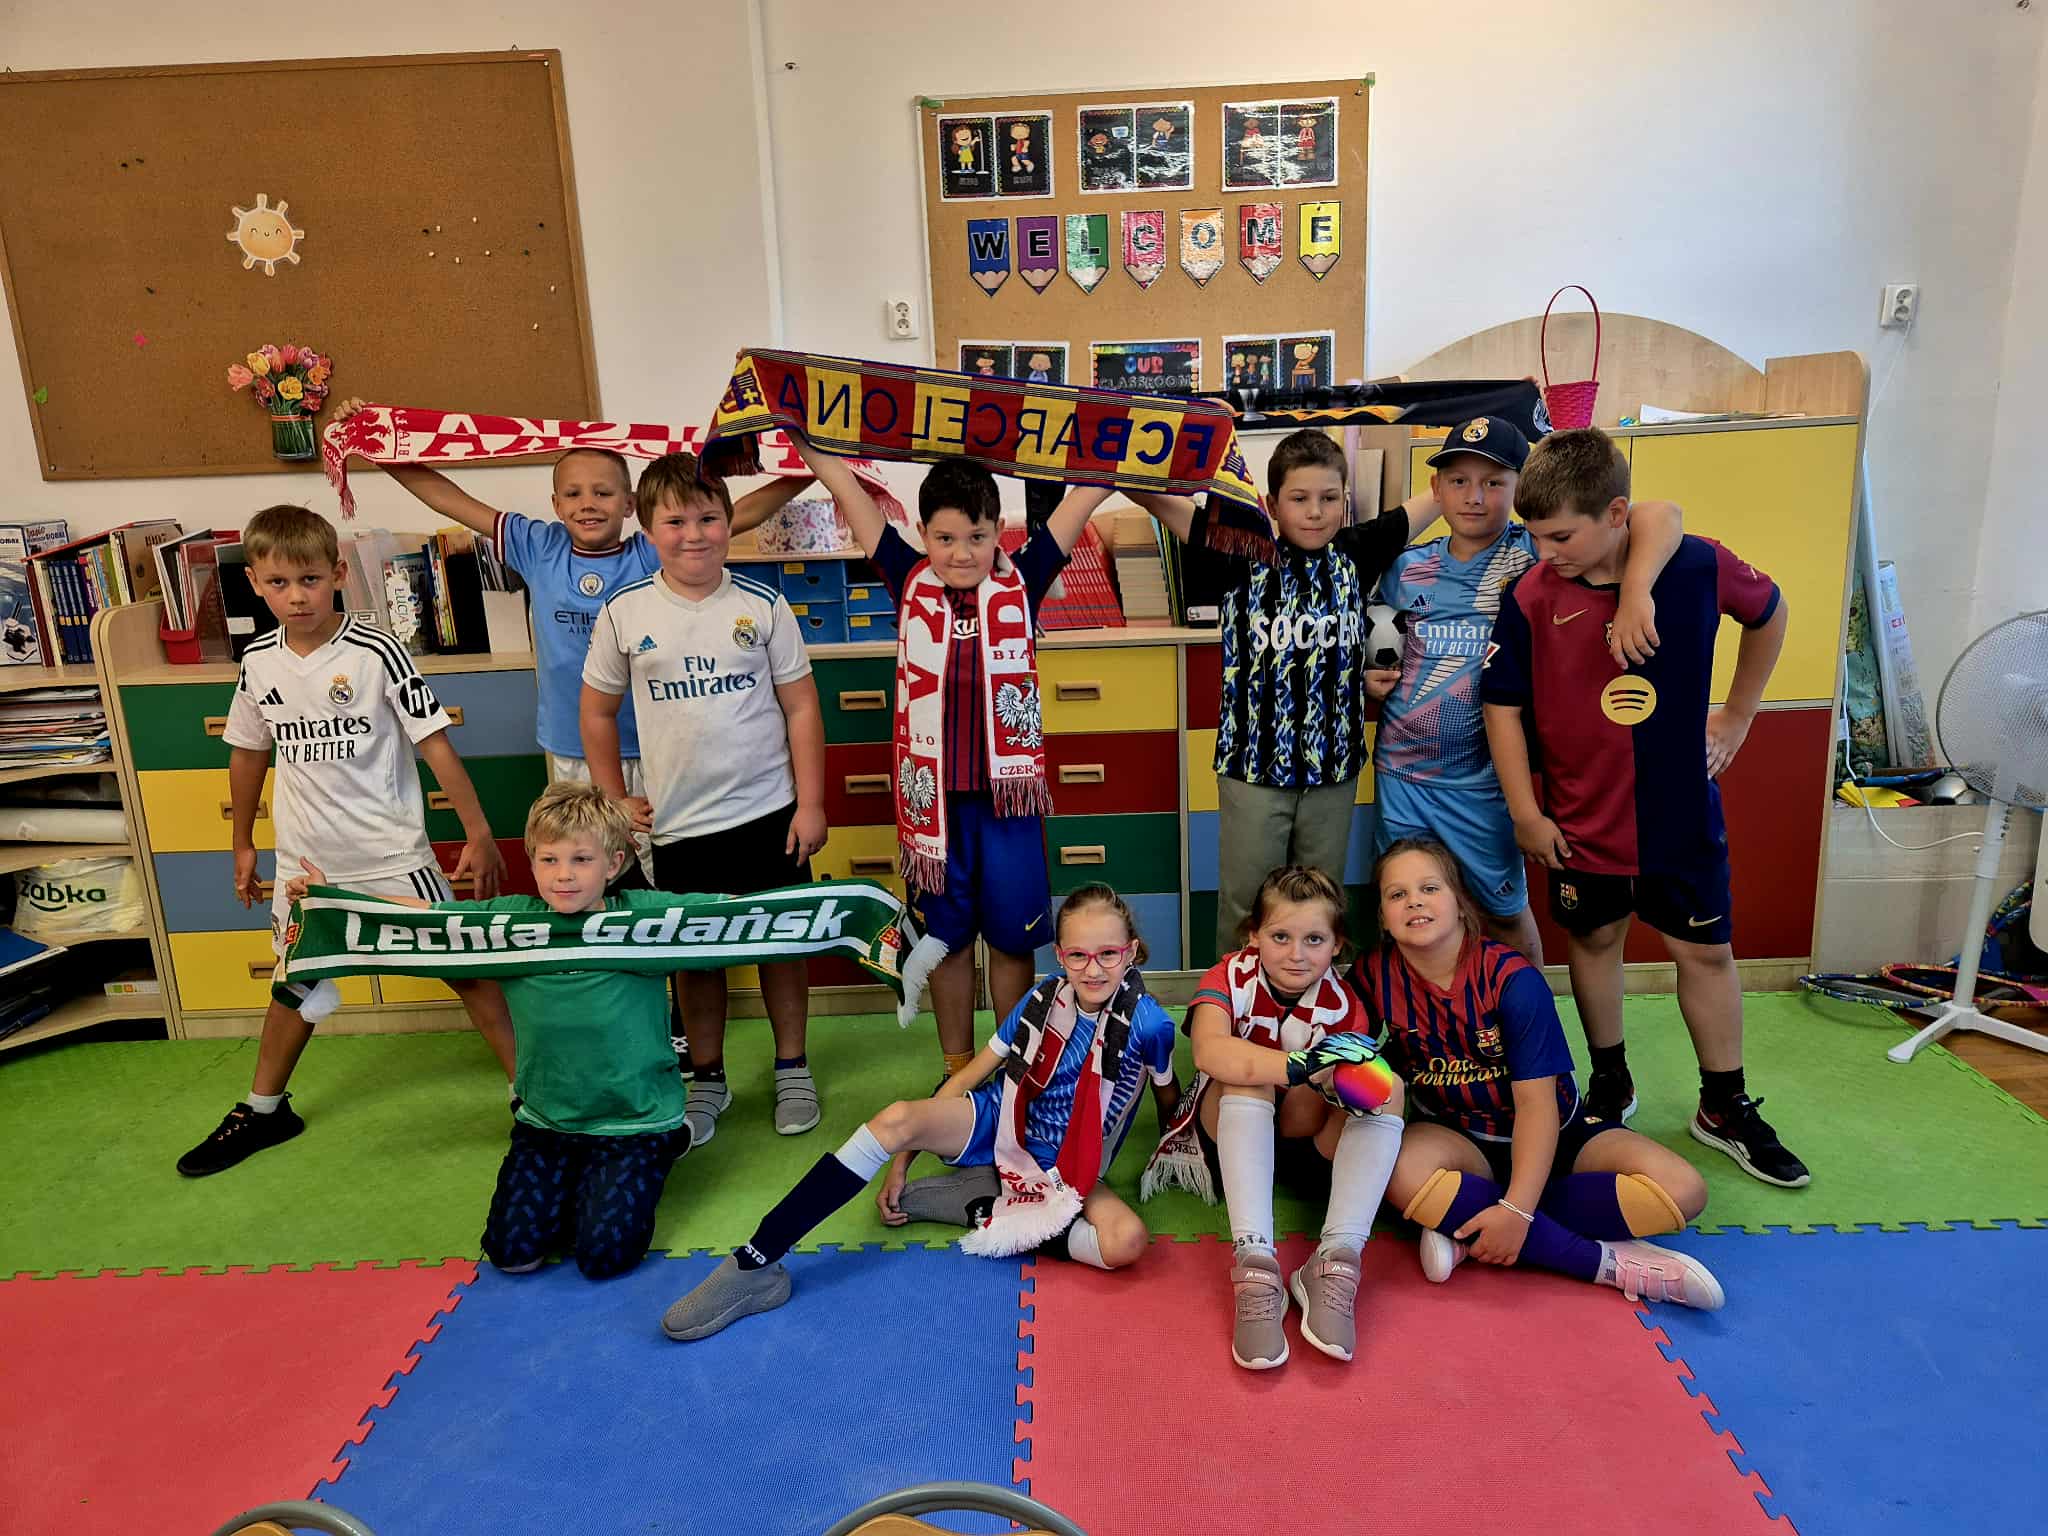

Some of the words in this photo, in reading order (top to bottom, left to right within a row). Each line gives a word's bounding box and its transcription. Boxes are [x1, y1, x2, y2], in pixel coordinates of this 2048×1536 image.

[1124, 356, 1164, 374] OUR
[1426, 641, 1445, 654] FLY
[684, 656, 716, 674] Fly
[407, 677, 436, 720] hp
[648, 671, 757, 701] Emirates
[265, 714, 372, 741] mirates
[304, 740, 356, 763] BETTER
[20, 875, 107, 904] żabka
[344, 910, 550, 954] Lechia
[581, 899, 854, 945] Gdańsk
